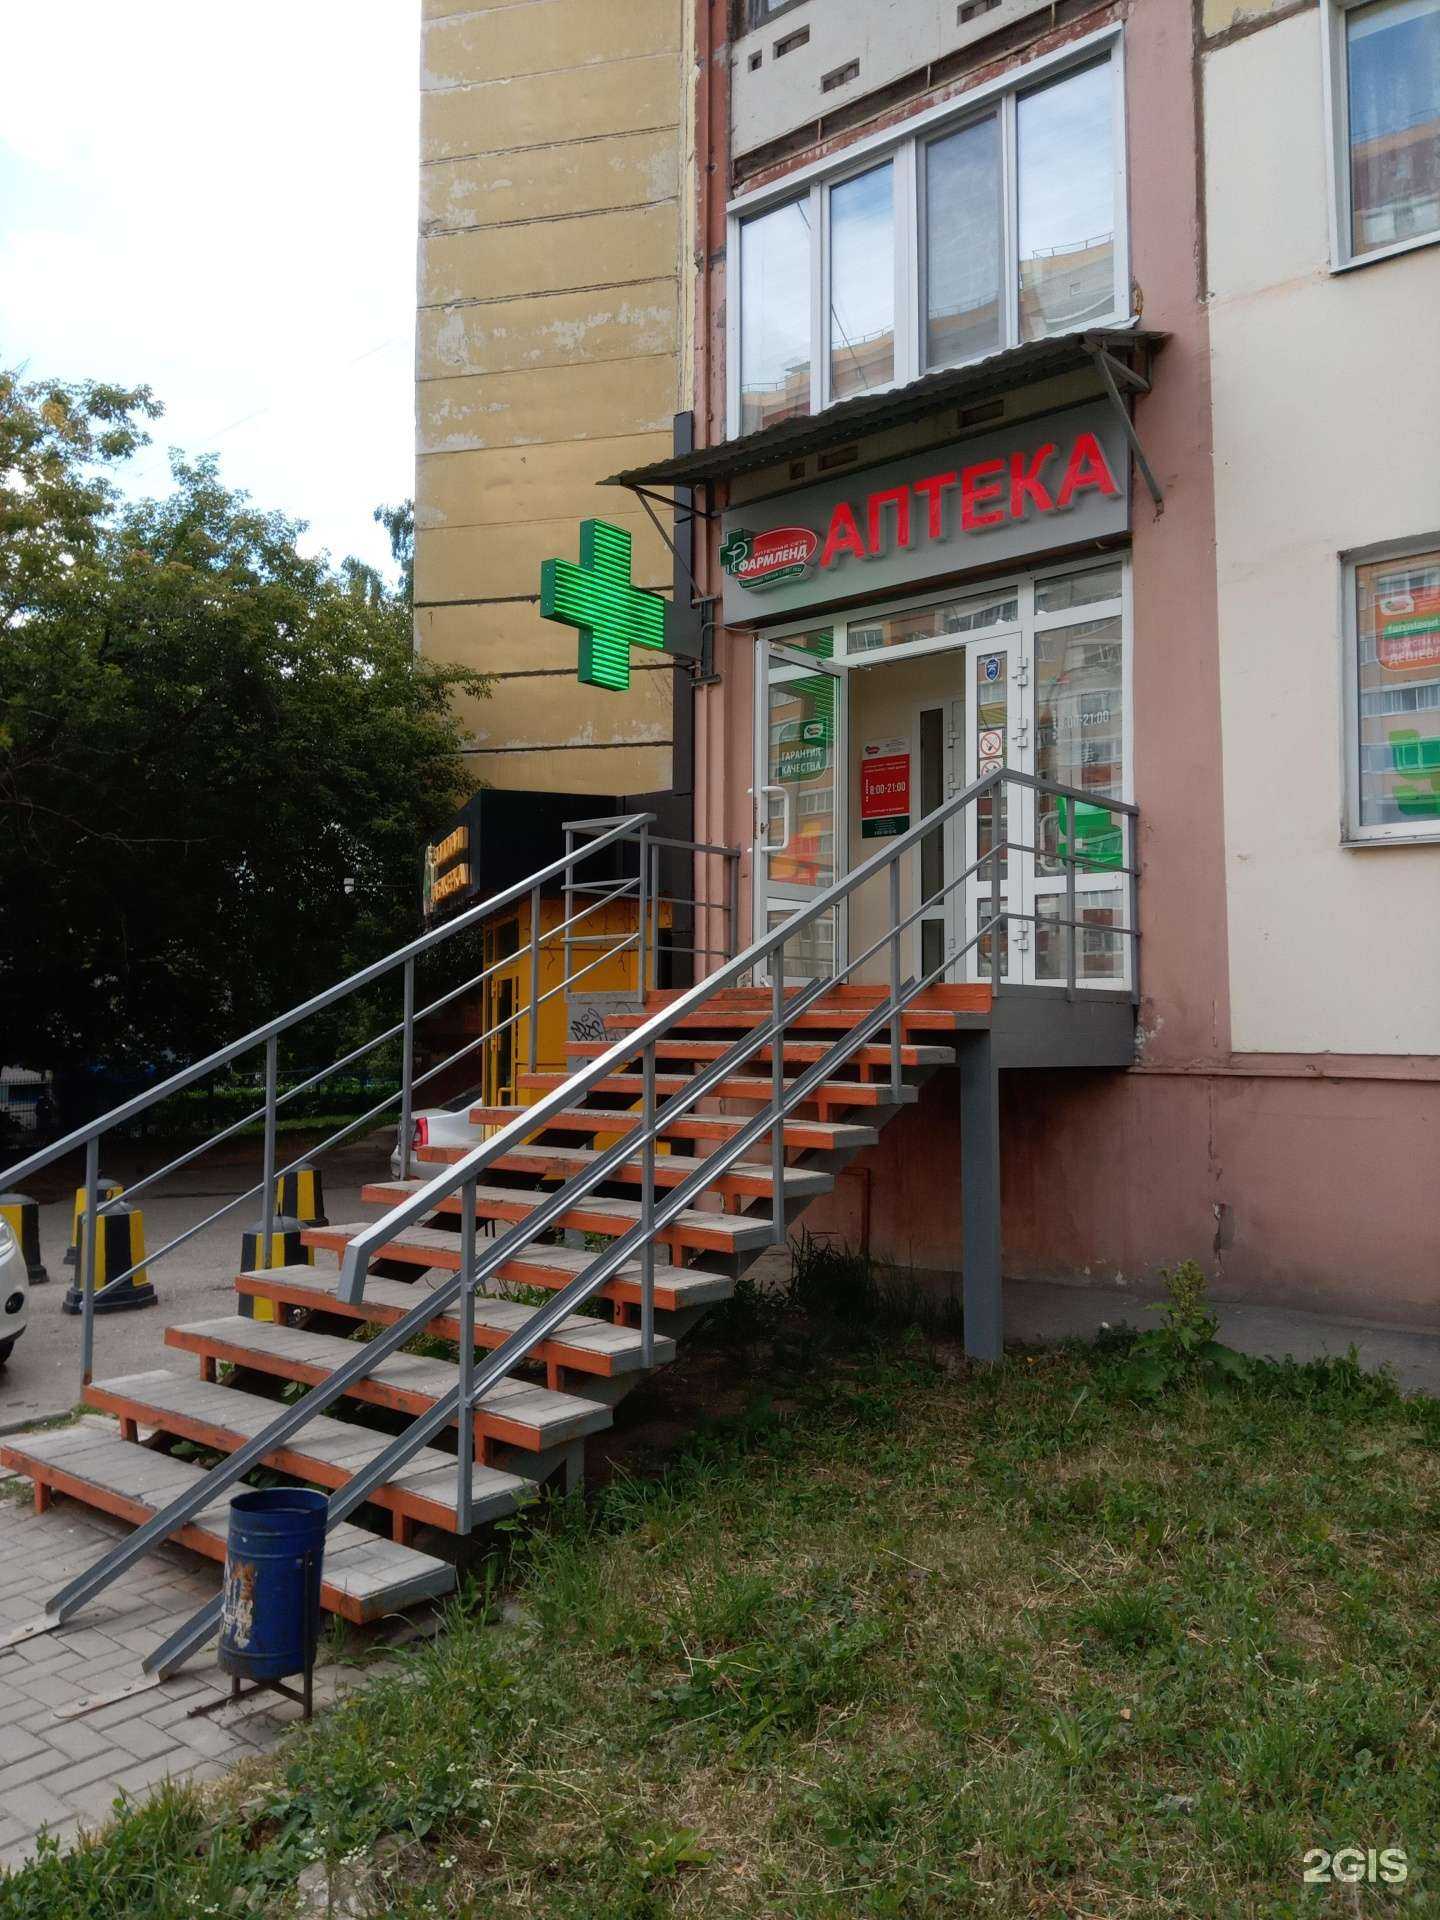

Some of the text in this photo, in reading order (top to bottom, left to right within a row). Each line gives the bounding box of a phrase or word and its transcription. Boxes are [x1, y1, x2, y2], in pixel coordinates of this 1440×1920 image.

[820, 432, 1120, 569] АПТЕКА
[739, 544, 808, 572] ФАРМЛЕНД
[781, 747, 823, 762] ГАРАНТИЯ
[781, 762, 822, 777] КАЧЕСТВА
